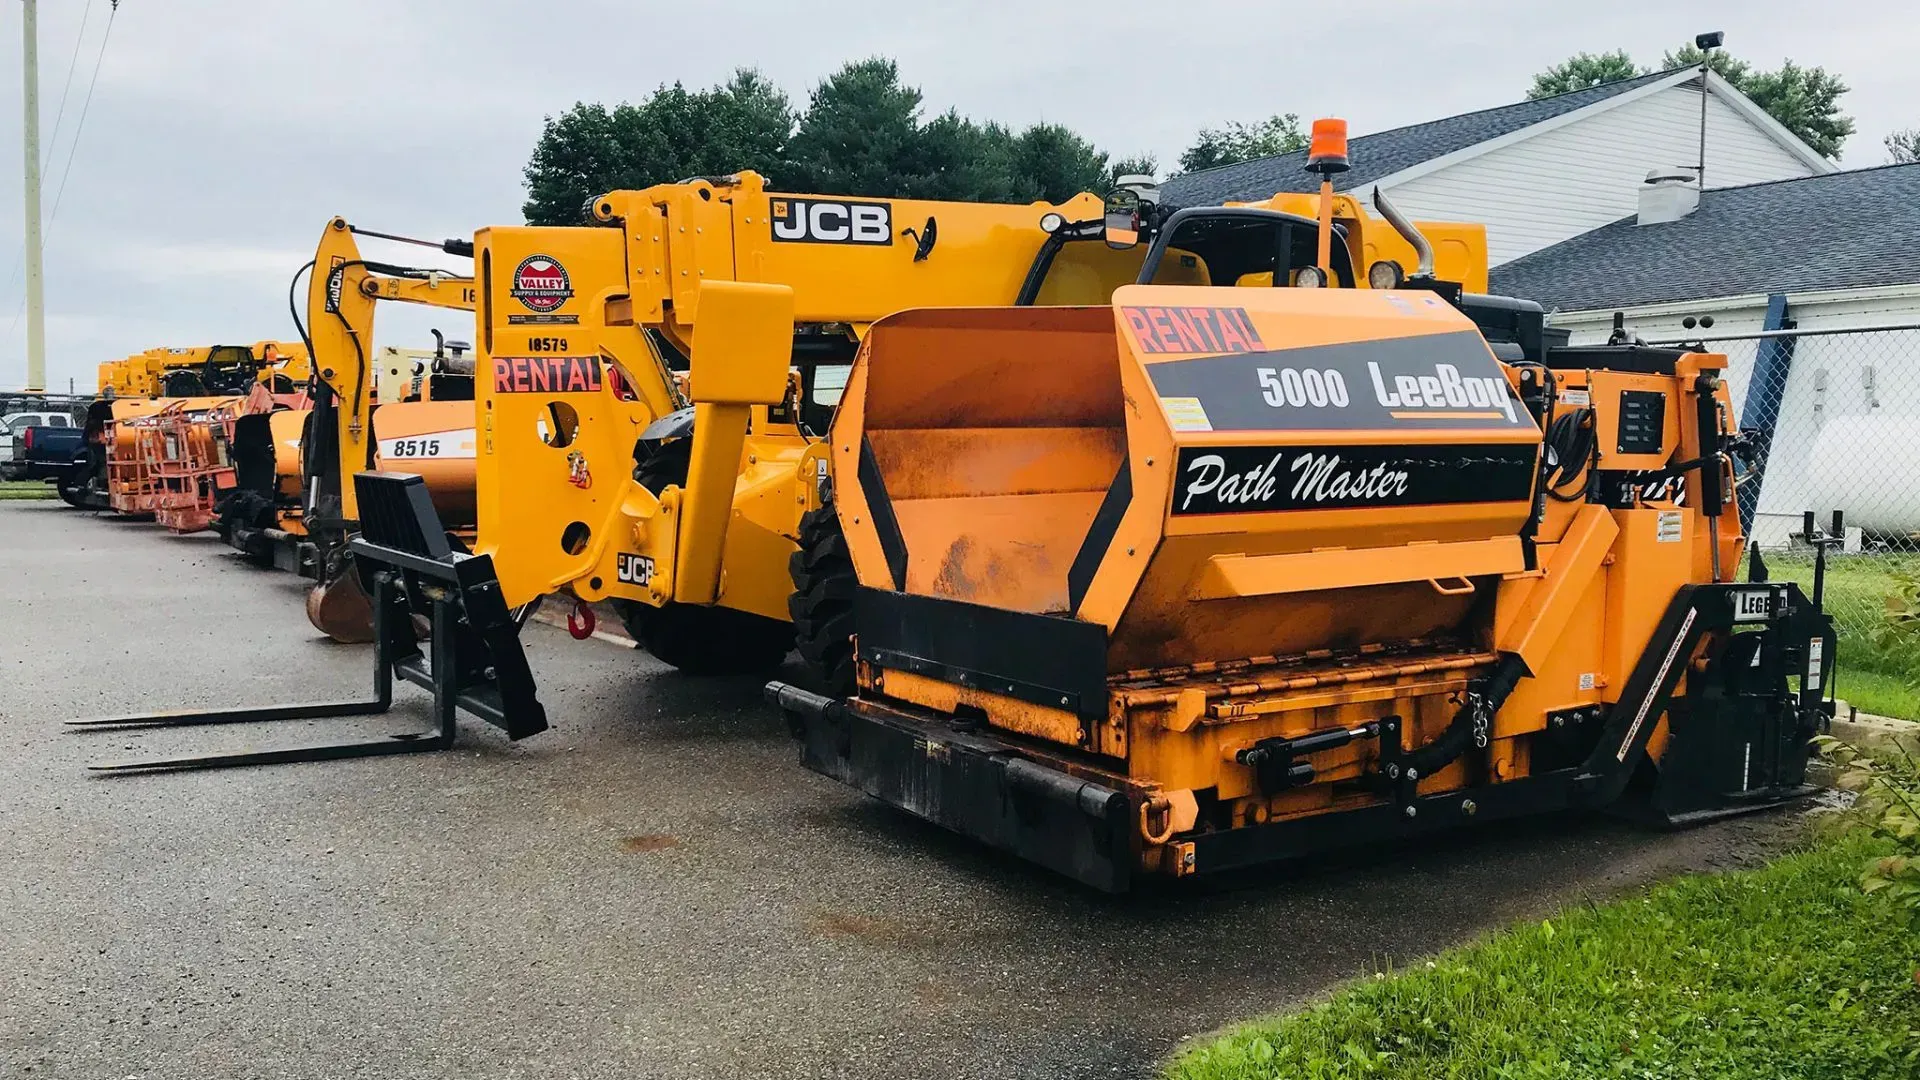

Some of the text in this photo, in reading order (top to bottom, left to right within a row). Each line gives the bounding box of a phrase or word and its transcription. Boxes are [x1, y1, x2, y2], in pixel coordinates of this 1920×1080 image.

[774, 202, 890, 242] JCB
[520, 279, 563, 289] VALLEY
[528, 338, 568, 352] 18579
[1123, 307, 1266, 353] RENTAL
[493, 358, 600, 392] RENTAL
[1256, 361, 1518, 423] 5000 LeeBoy
[394, 440, 440, 456] 8515
[1182, 452, 1408, 510] Path Master
[1741, 593, 1786, 614] LEGED
